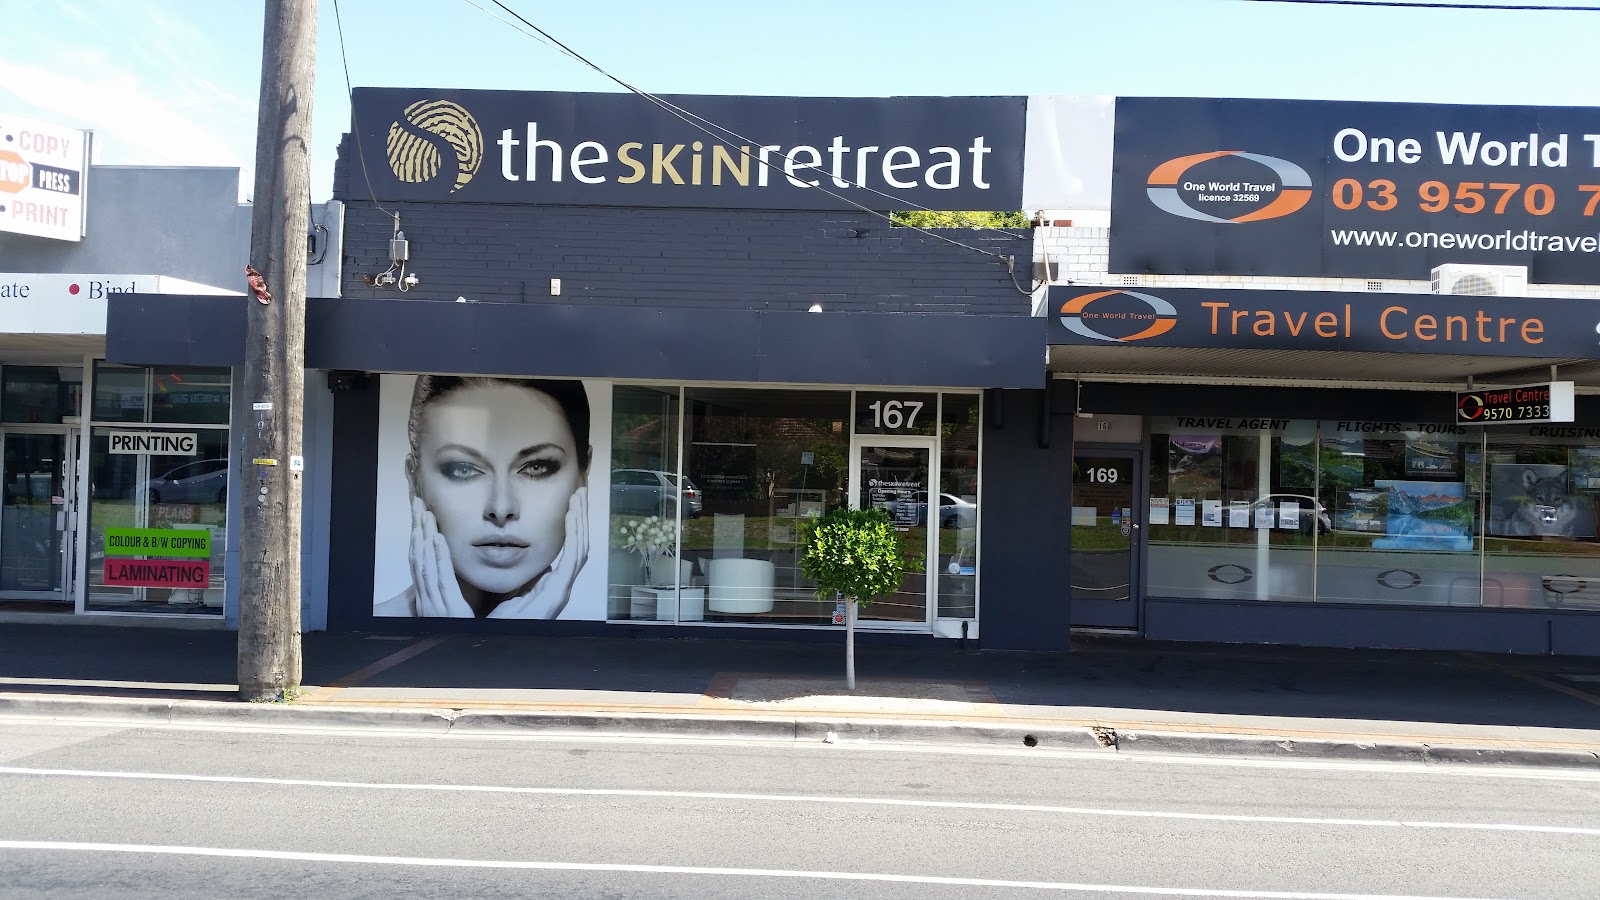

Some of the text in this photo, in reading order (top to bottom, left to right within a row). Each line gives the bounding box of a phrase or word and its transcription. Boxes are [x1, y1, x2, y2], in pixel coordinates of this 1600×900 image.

[20, 130, 70, 158] COPY
[1333, 128, 1422, 164] One
[1436, 131, 1568, 168] World
[39, 169, 70, 193] PRESS
[1183, 181, 1276, 192] One World Travel
[1198, 193, 1260, 202] licence 32569
[1332, 178, 1398, 211] 03
[1418, 180, 1556, 216] 9570
[12, 200, 69, 228] PRINT
[1082, 311, 1156, 321] One World Travel
[1200, 302, 1544, 345] Travel Centre
[1483, 388, 1550, 405] Travel Centre
[868, 400, 924, 429] 167
[1483, 405, 1550, 421] 9570 7333
[1176, 417, 1291, 431] TRAVEL AGENT
[1336, 421, 1402, 434] FLIGHTS
[1416, 423, 1467, 436] TOURS
[111, 435, 194, 452] PRINTING
[1086, 467, 1118, 483] 169
[157, 506, 193, 520] PLANS
[109, 535, 206, 550] COLOUR & B/W COPYING
[108, 564, 204, 583] LAMINATING
